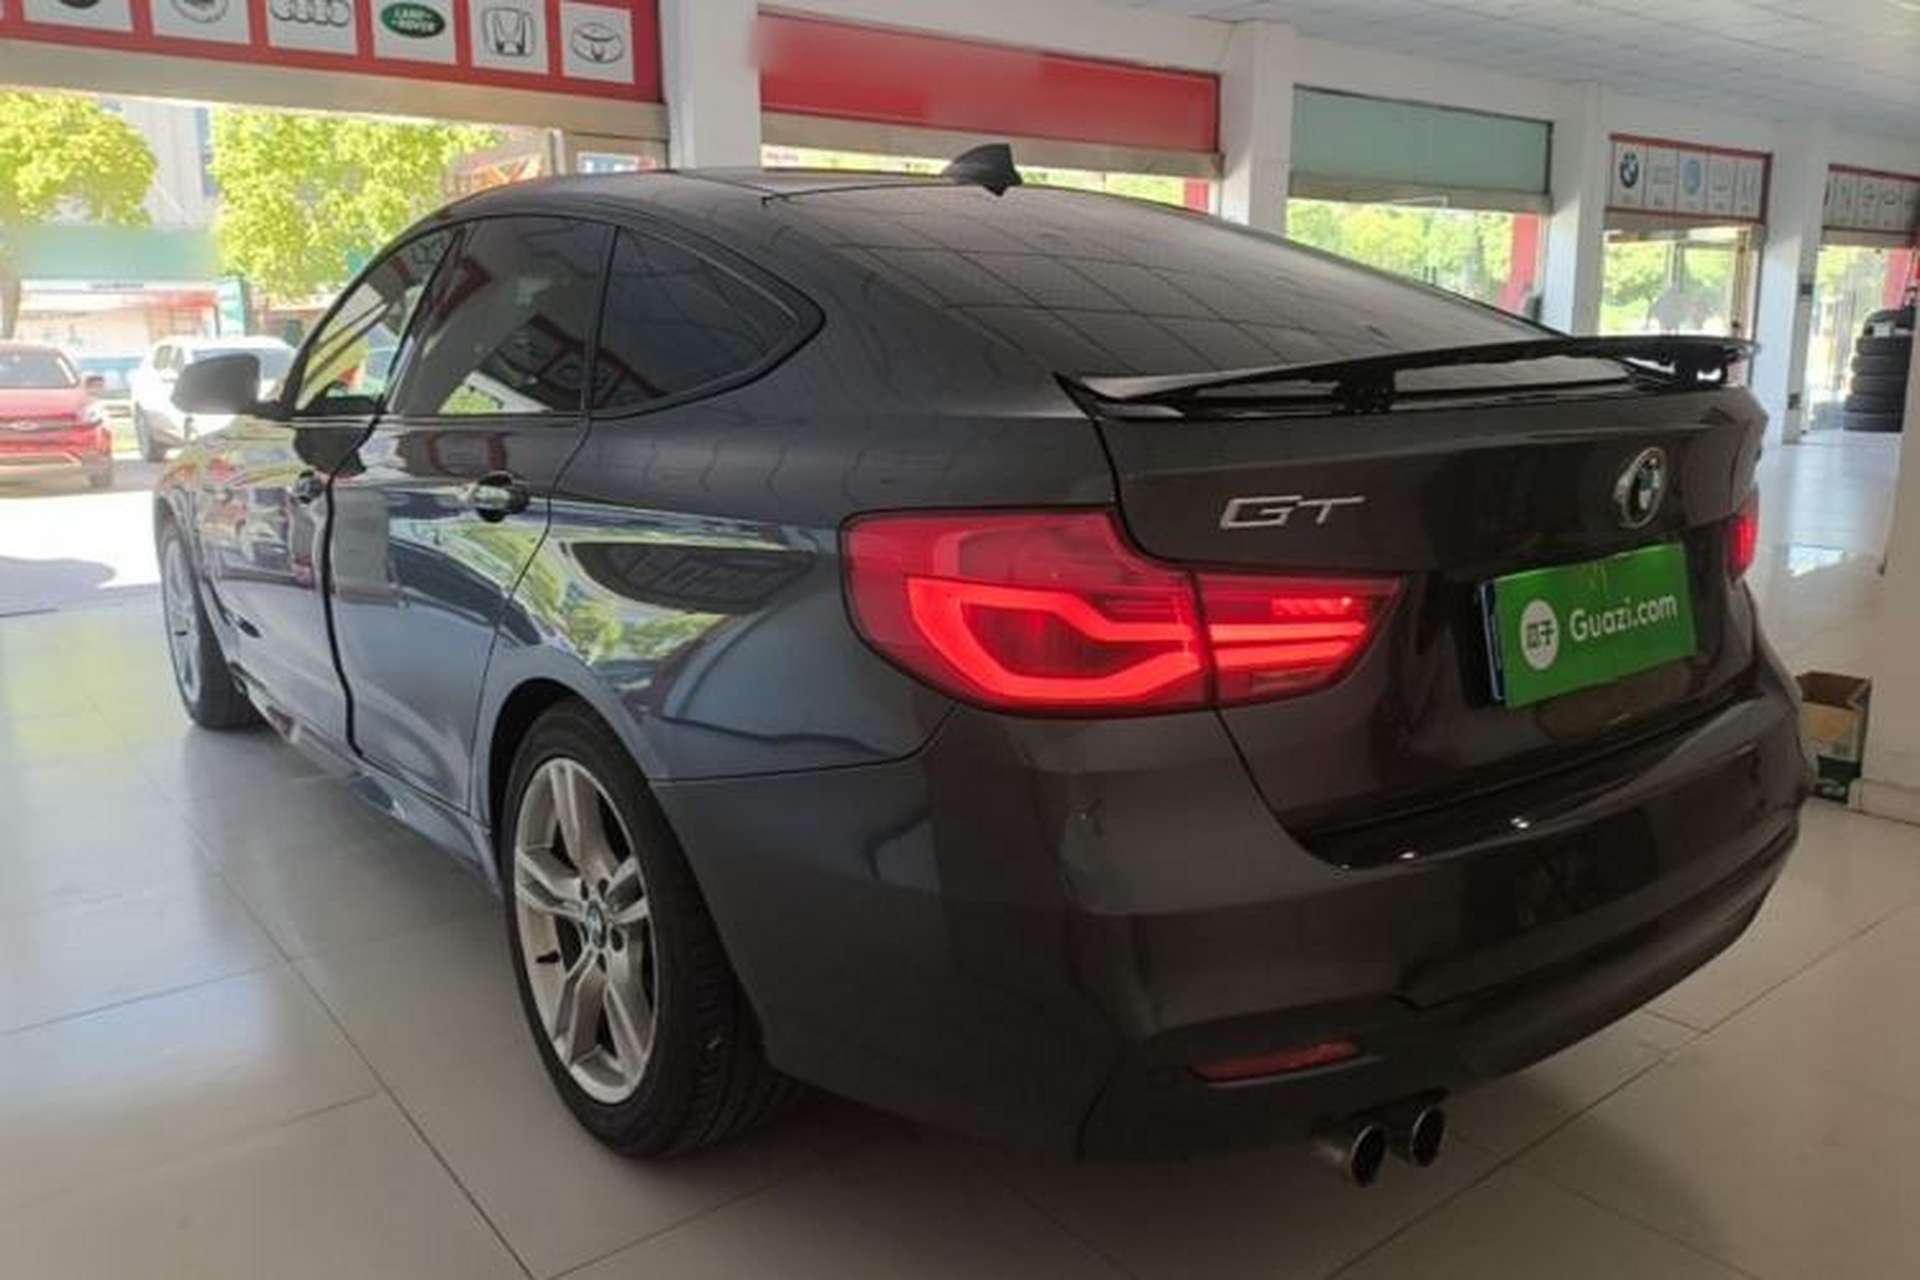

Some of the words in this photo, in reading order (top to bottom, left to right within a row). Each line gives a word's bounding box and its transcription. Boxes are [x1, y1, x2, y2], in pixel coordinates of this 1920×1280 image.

[394, 7, 426, 19] LAND
[398, 19, 436, 33] ROVER
[1220, 495, 1365, 528] GT
[1568, 593, 1679, 642] Guazi.com
